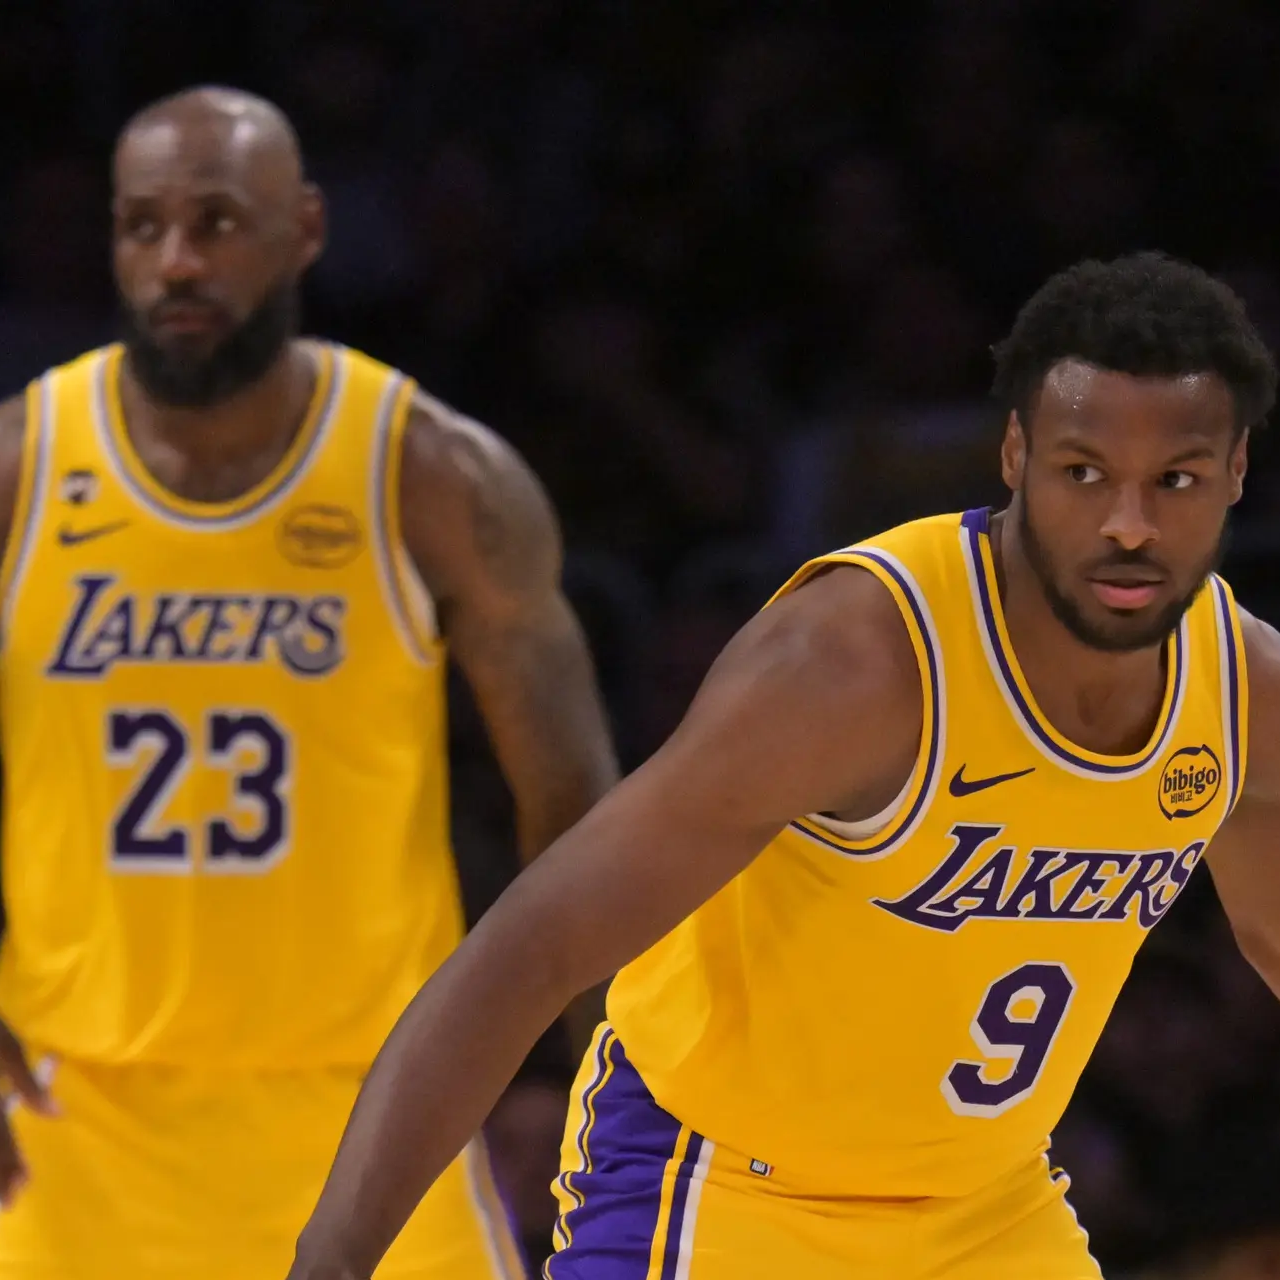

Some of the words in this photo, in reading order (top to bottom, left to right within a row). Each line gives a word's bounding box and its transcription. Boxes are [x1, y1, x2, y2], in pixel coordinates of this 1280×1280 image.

[45, 572, 346, 680] LAKERS
[105, 706, 292, 876] 23
[1163, 765, 1217, 795] bibigo
[1170, 790, 1193, 804] 비비고
[868, 822, 1209, 934] LAKERS
[939, 960, 1078, 1119] 9
